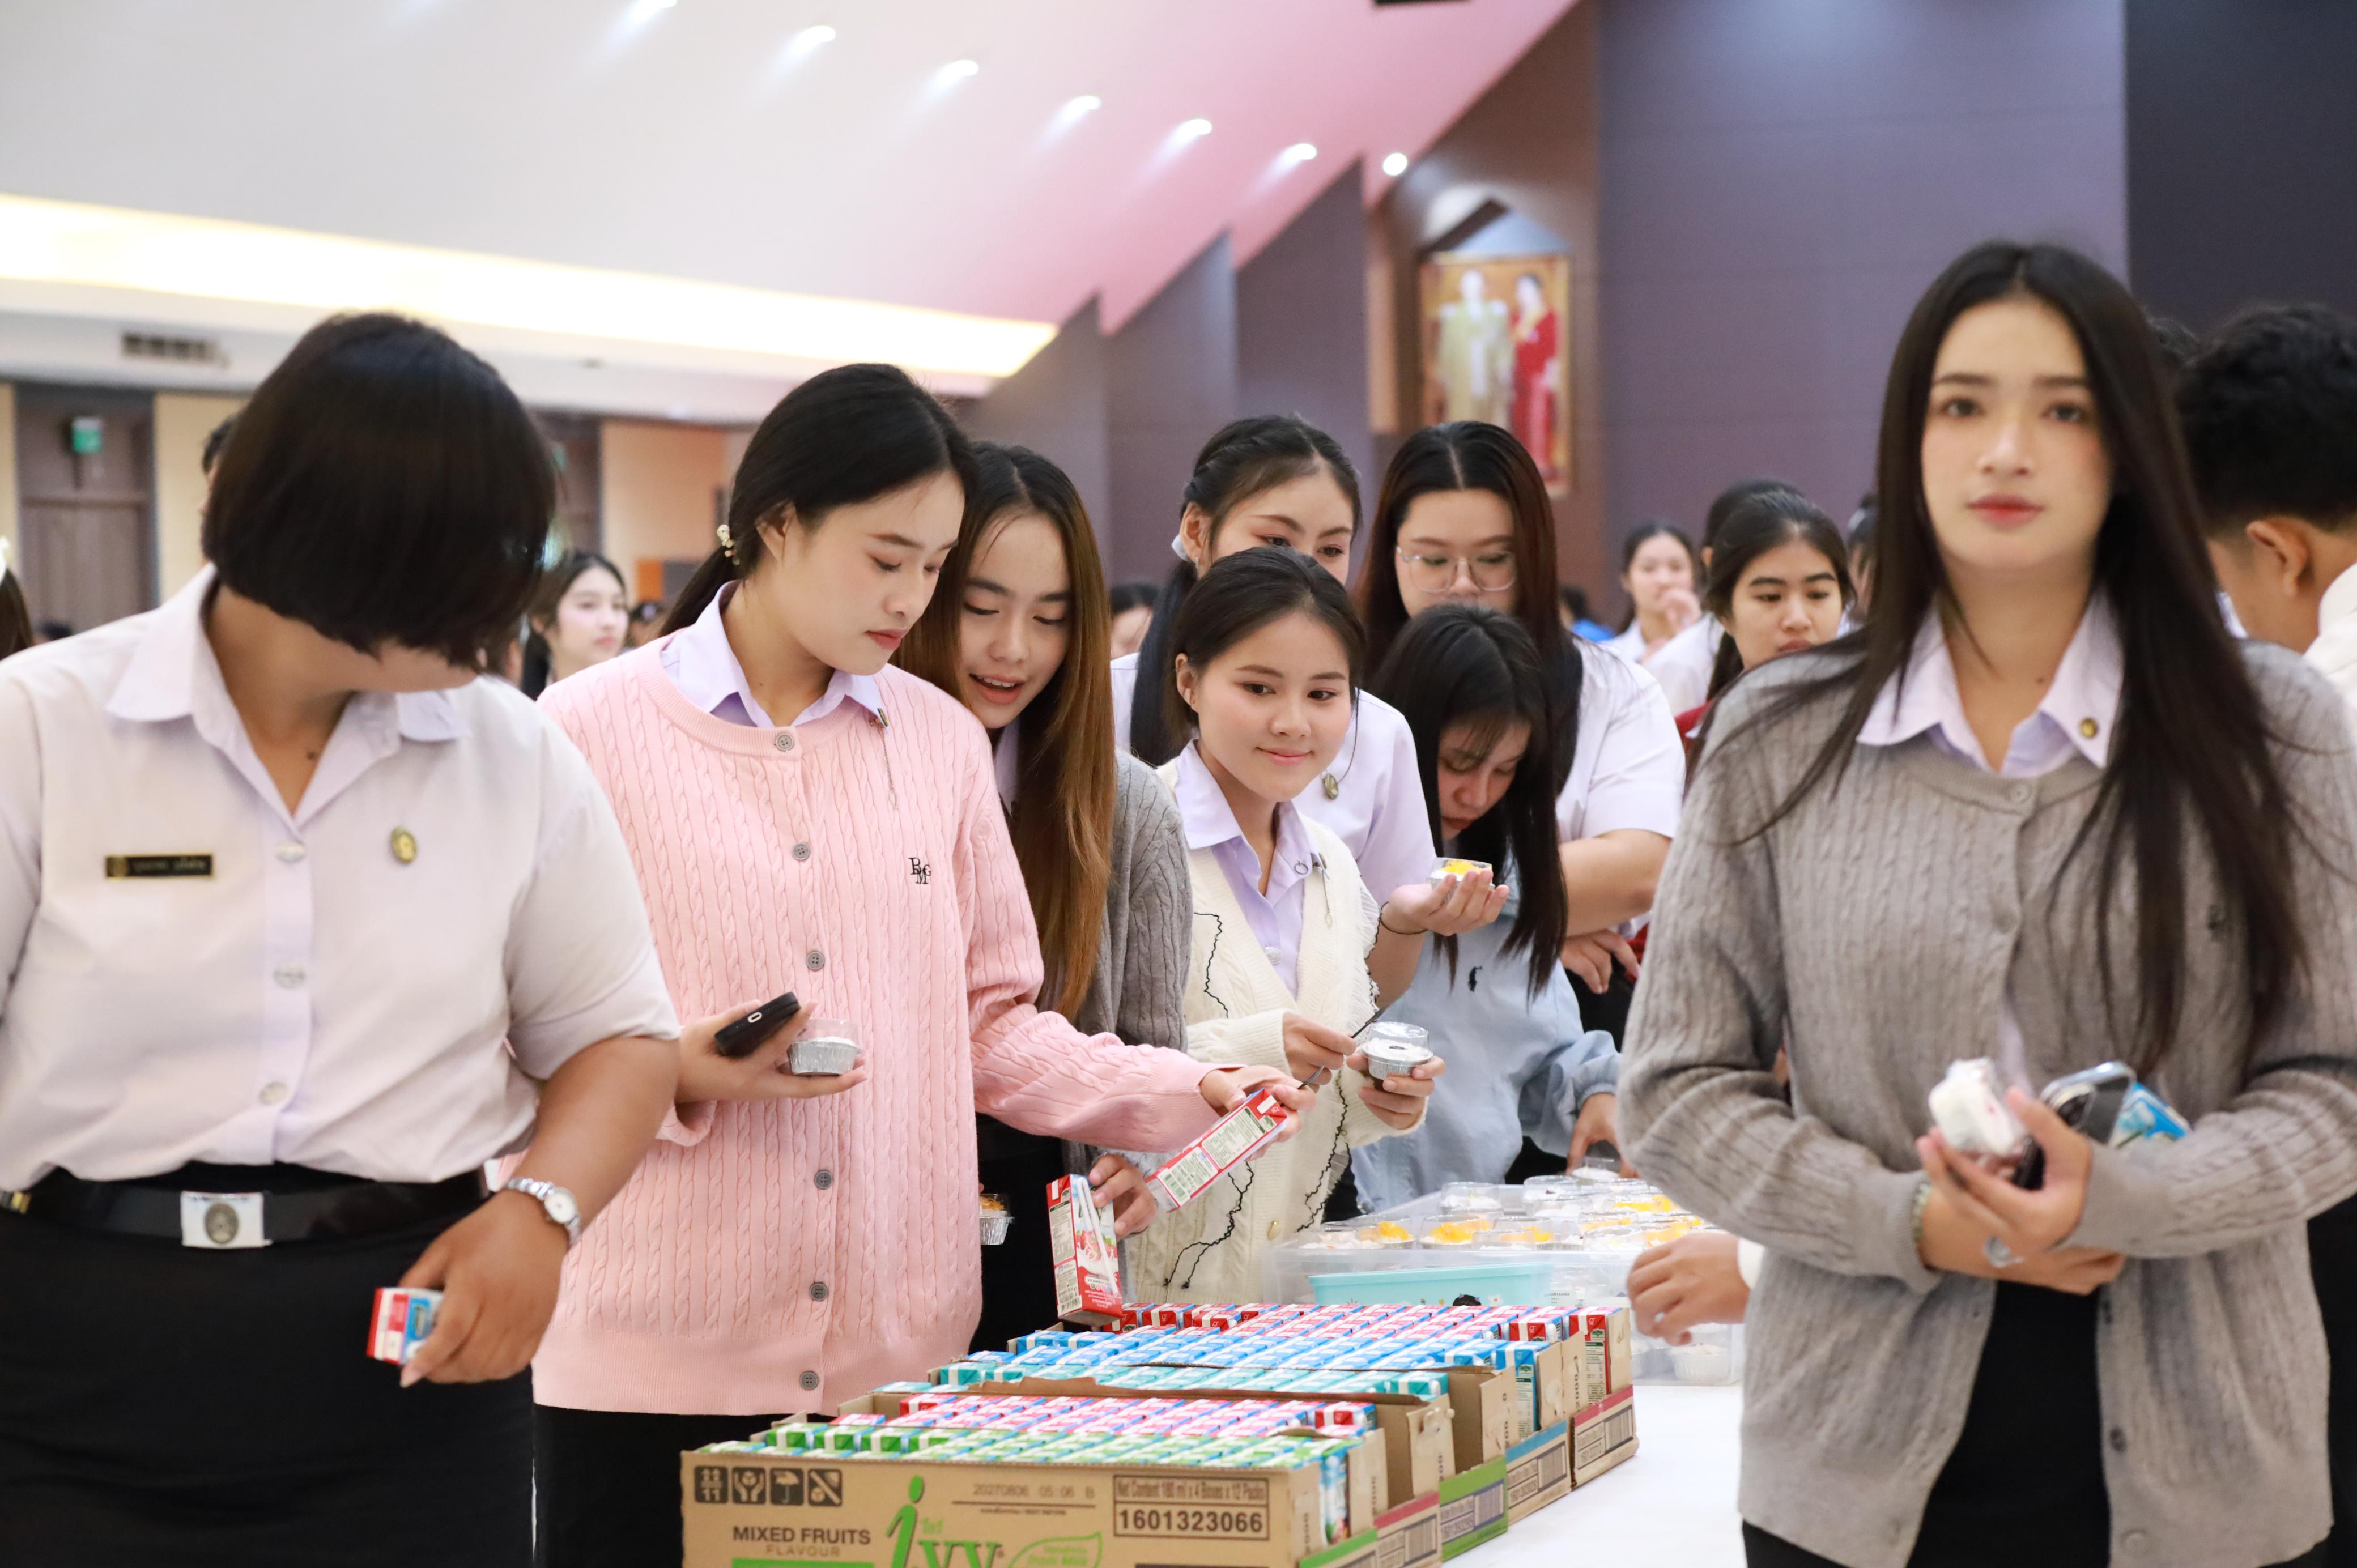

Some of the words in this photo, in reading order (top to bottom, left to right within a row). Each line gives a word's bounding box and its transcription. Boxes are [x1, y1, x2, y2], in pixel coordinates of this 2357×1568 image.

[1120, 1510, 1262, 1532] 1601323066
[733, 1527, 795, 1543] MIXED
[801, 1528, 871, 1545] FRUITS
[765, 1545, 840, 1557] FLAVOUR
